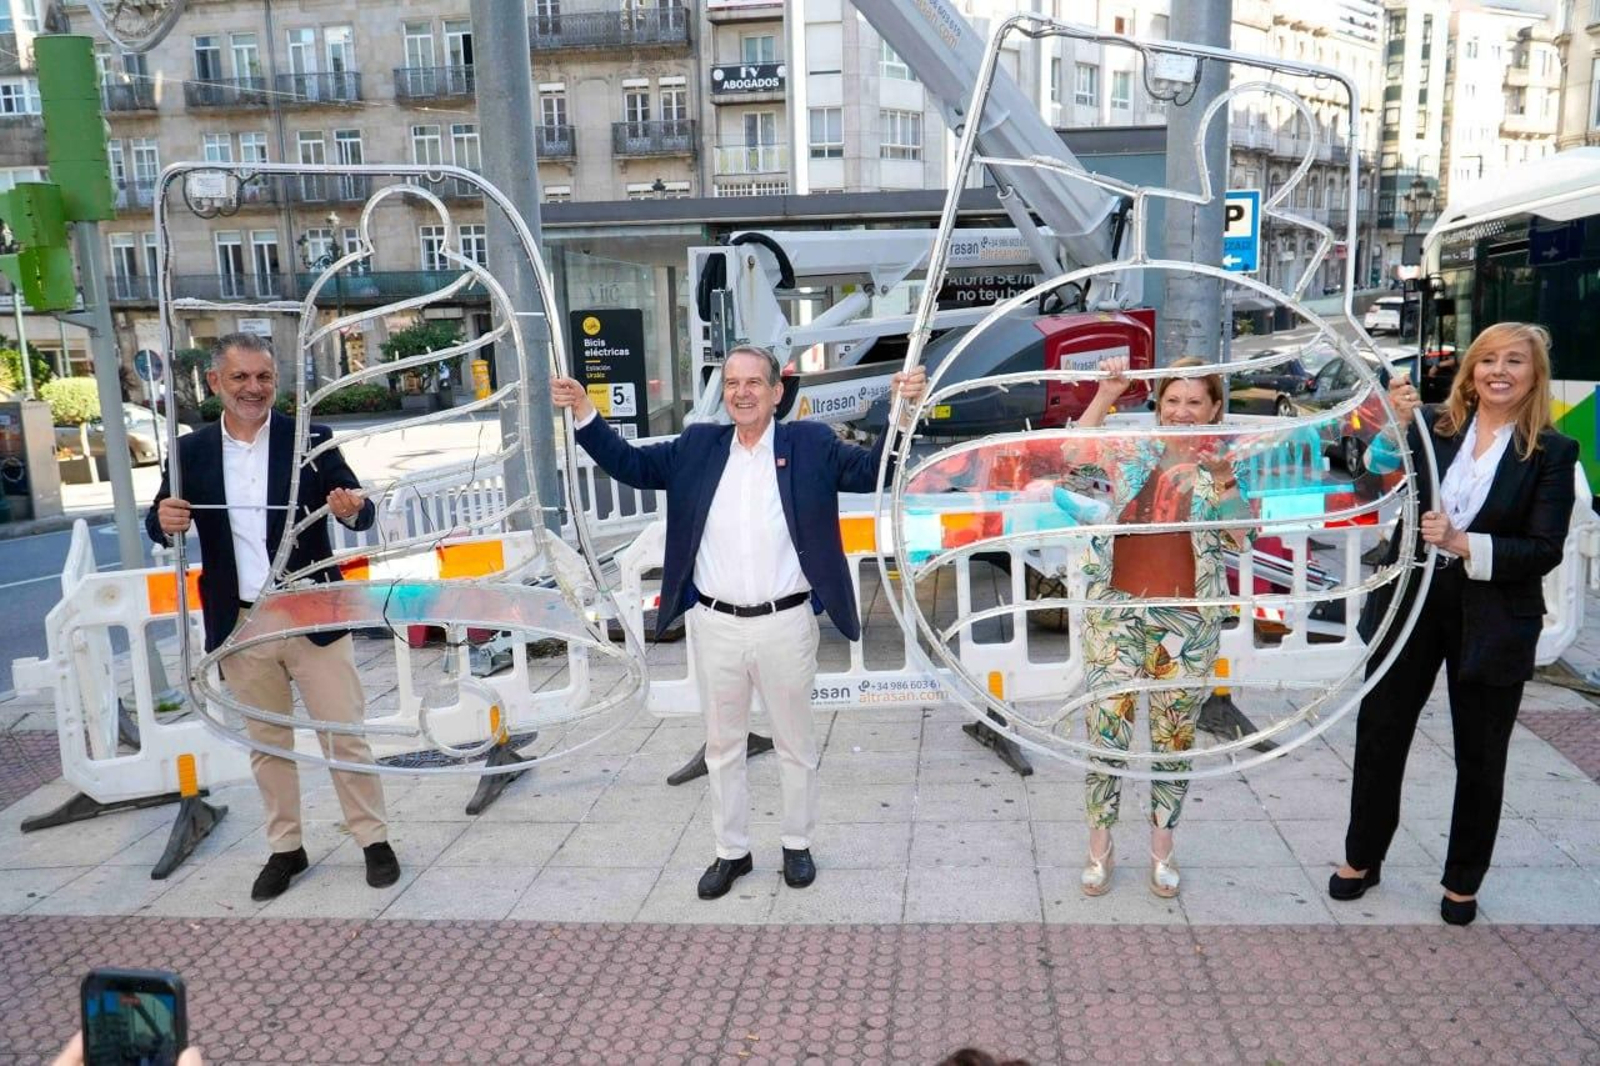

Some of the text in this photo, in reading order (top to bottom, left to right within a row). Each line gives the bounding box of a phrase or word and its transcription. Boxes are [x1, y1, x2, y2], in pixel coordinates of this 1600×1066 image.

[723, 78, 779, 89] ABOGADOS
[1225, 205, 1245, 231] P
[950, 242, 979, 256] rasan
[956, 290, 977, 301] no
[979, 287, 1004, 301] teu
[584, 339, 606, 347] Bicis
[584, 348, 630, 357] eléctricas
[797, 395, 856, 421] Altrasan
[871, 683, 888, 691] +34
[890, 682, 908, 690] 986
[910, 681, 928, 689] 603
[810, 687, 851, 700] asan
[860, 690, 949, 703] altrasan.com
